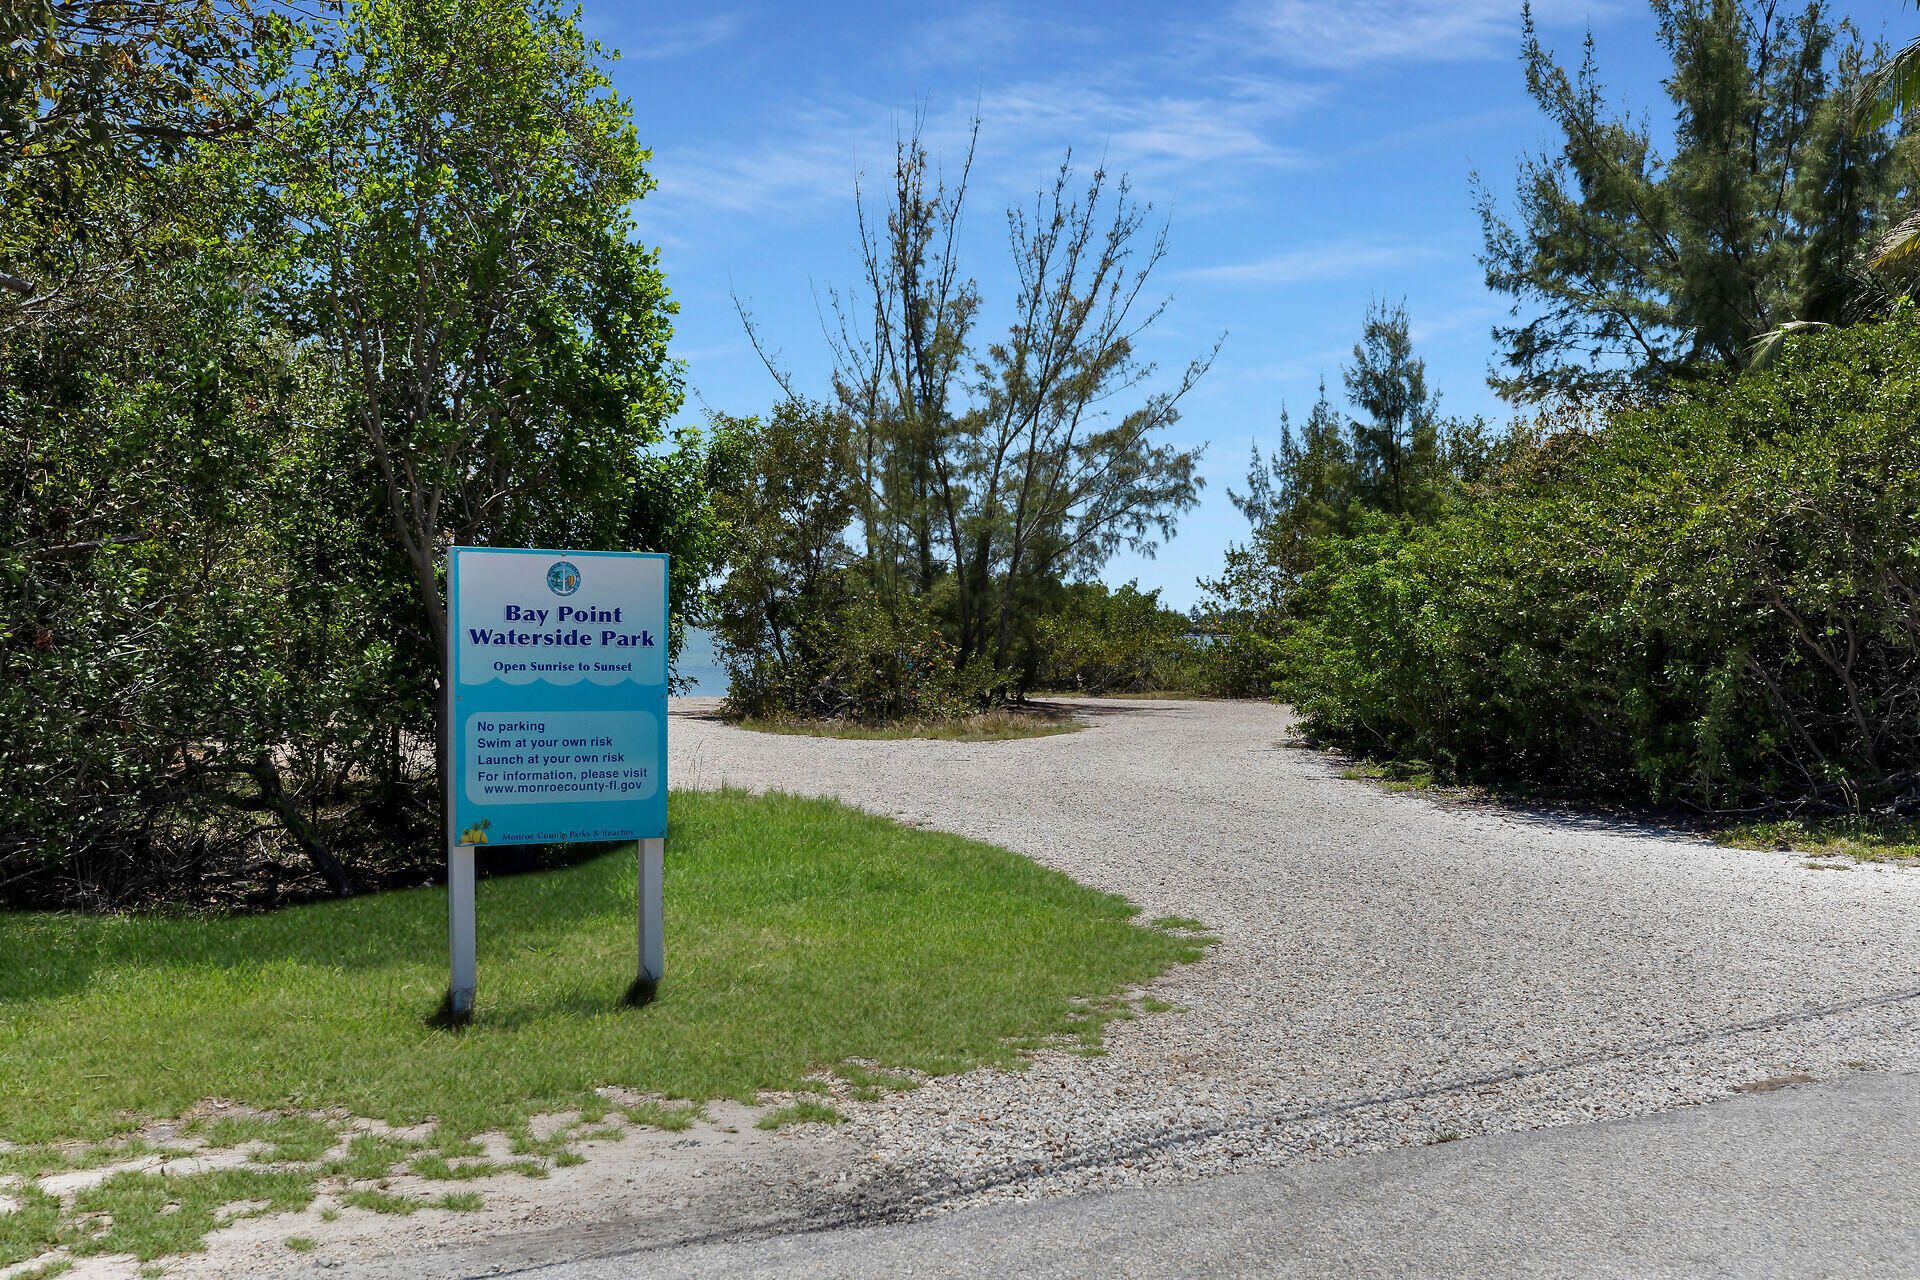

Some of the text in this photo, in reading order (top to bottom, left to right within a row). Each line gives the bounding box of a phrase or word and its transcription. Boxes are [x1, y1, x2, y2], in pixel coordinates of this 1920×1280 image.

[505, 605, 622, 626] Bay Point
[469, 629, 655, 647] Waterside Park
[494, 662, 632, 673] Open Sunrise to Sunset
[478, 721, 545, 733] No parking
[478, 737, 612, 749] Swim at your own risk
[478, 753, 624, 766] Launch at your own risk
[478, 768, 648, 781] For information, please visit
[484, 781, 642, 793] www.monroecounty-fl.gov
